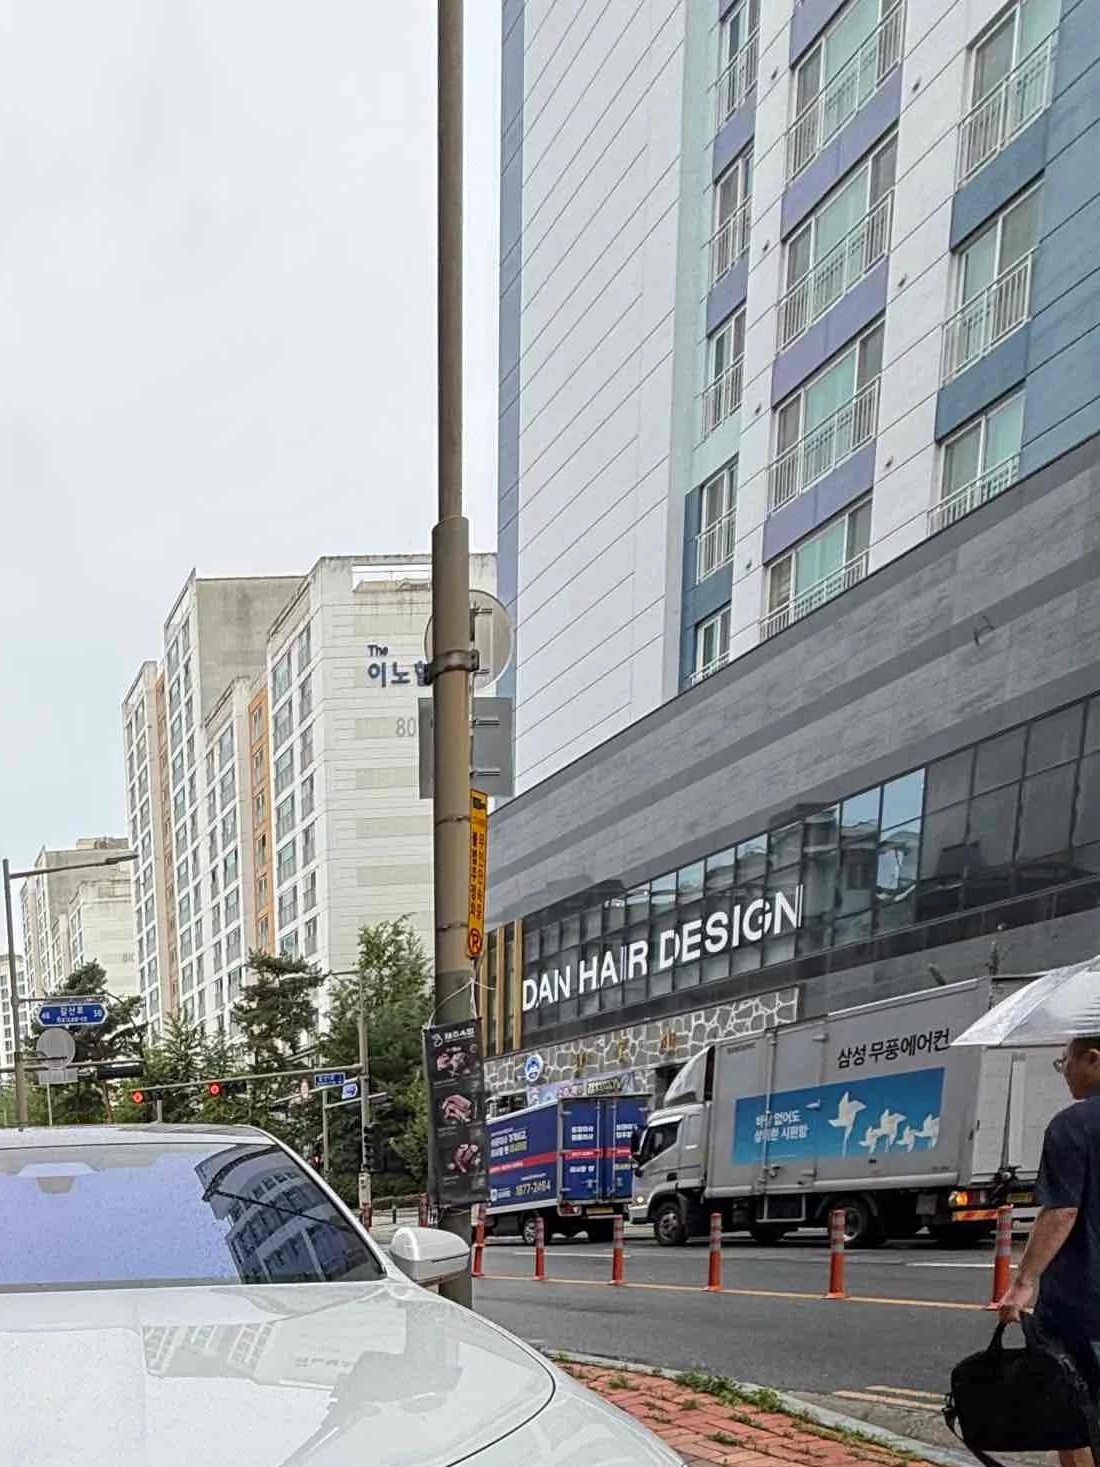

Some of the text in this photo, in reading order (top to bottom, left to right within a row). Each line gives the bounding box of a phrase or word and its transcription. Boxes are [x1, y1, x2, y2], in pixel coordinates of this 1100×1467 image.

[367, 645, 388, 656] The
[522, 884, 804, 1012] DAN HAIR DESIGN
[837, 1044, 866, 1069] 삼성
